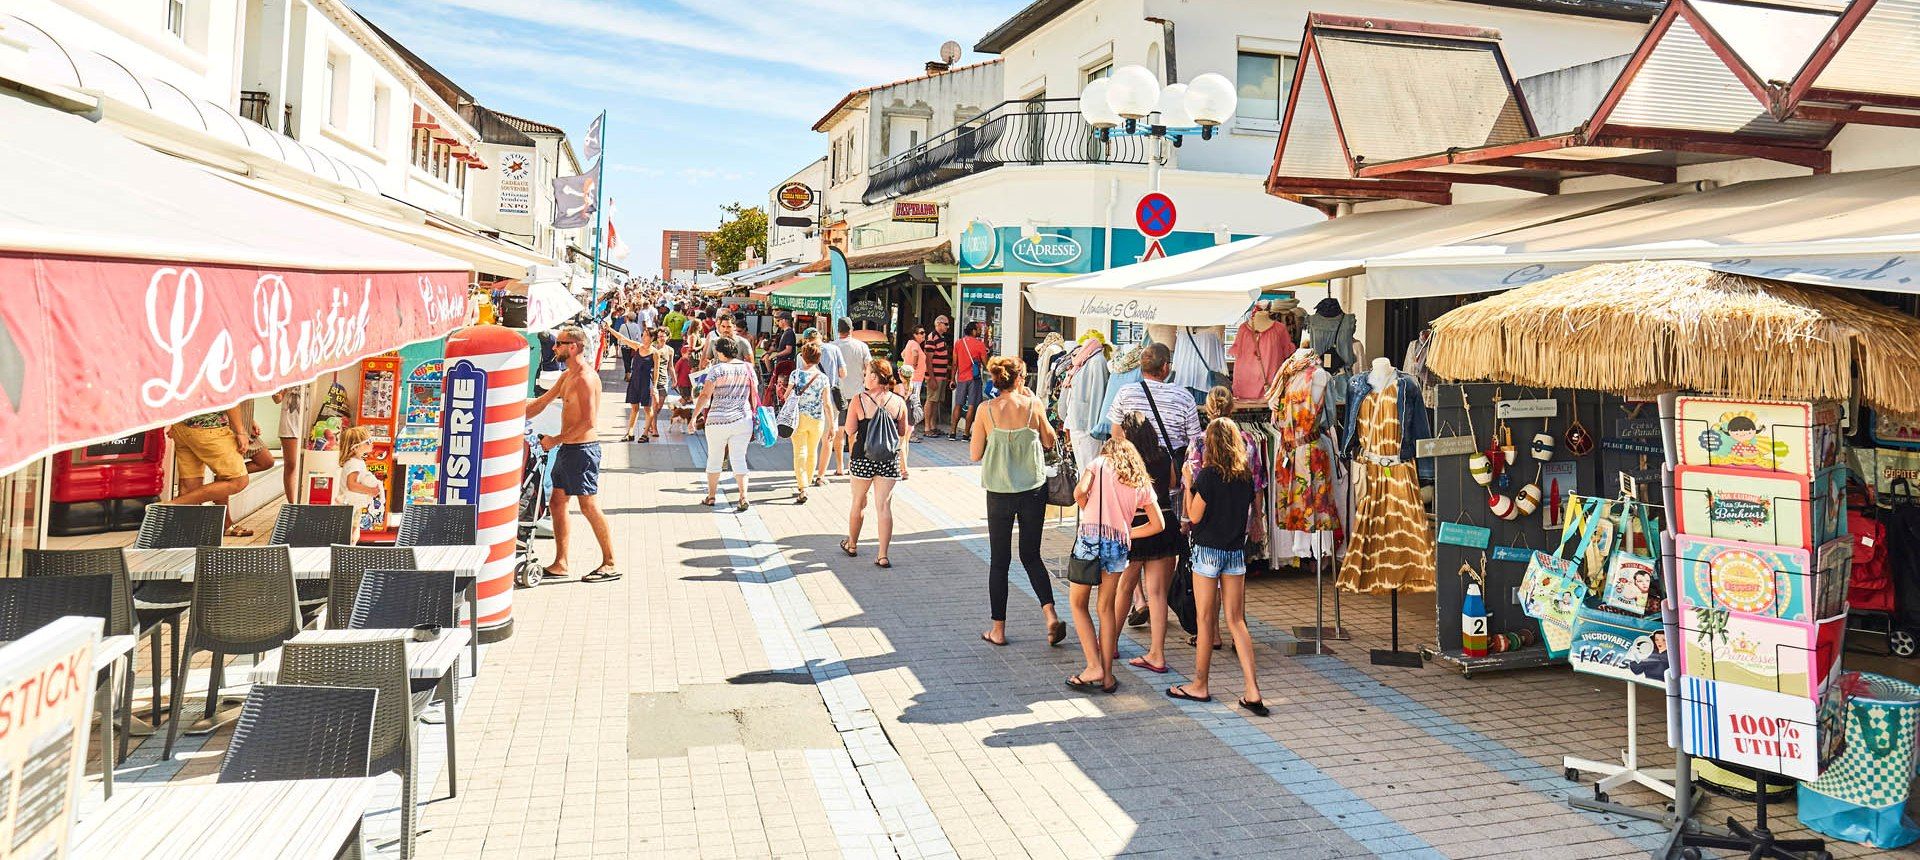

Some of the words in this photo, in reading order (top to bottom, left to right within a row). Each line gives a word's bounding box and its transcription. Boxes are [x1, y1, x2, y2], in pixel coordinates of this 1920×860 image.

[896, 202, 937, 216] DESPERADOS
[1018, 243, 1076, 262] L'ADRESSE
[142, 267, 237, 408] Le
[251, 273, 372, 382] Rustick
[1545, 463, 1573, 473] BEACH
[1885, 468, 1917, 479] POPOTE
[1715, 508, 1767, 519] Bonheurs
[1473, 619, 1485, 634] 2
[1581, 633, 1631, 650] INCROYABLE
[1579, 645, 1631, 669] FRAIS
[1729, 714, 1800, 740] 100%
[1733, 737, 1802, 760] UTILE
